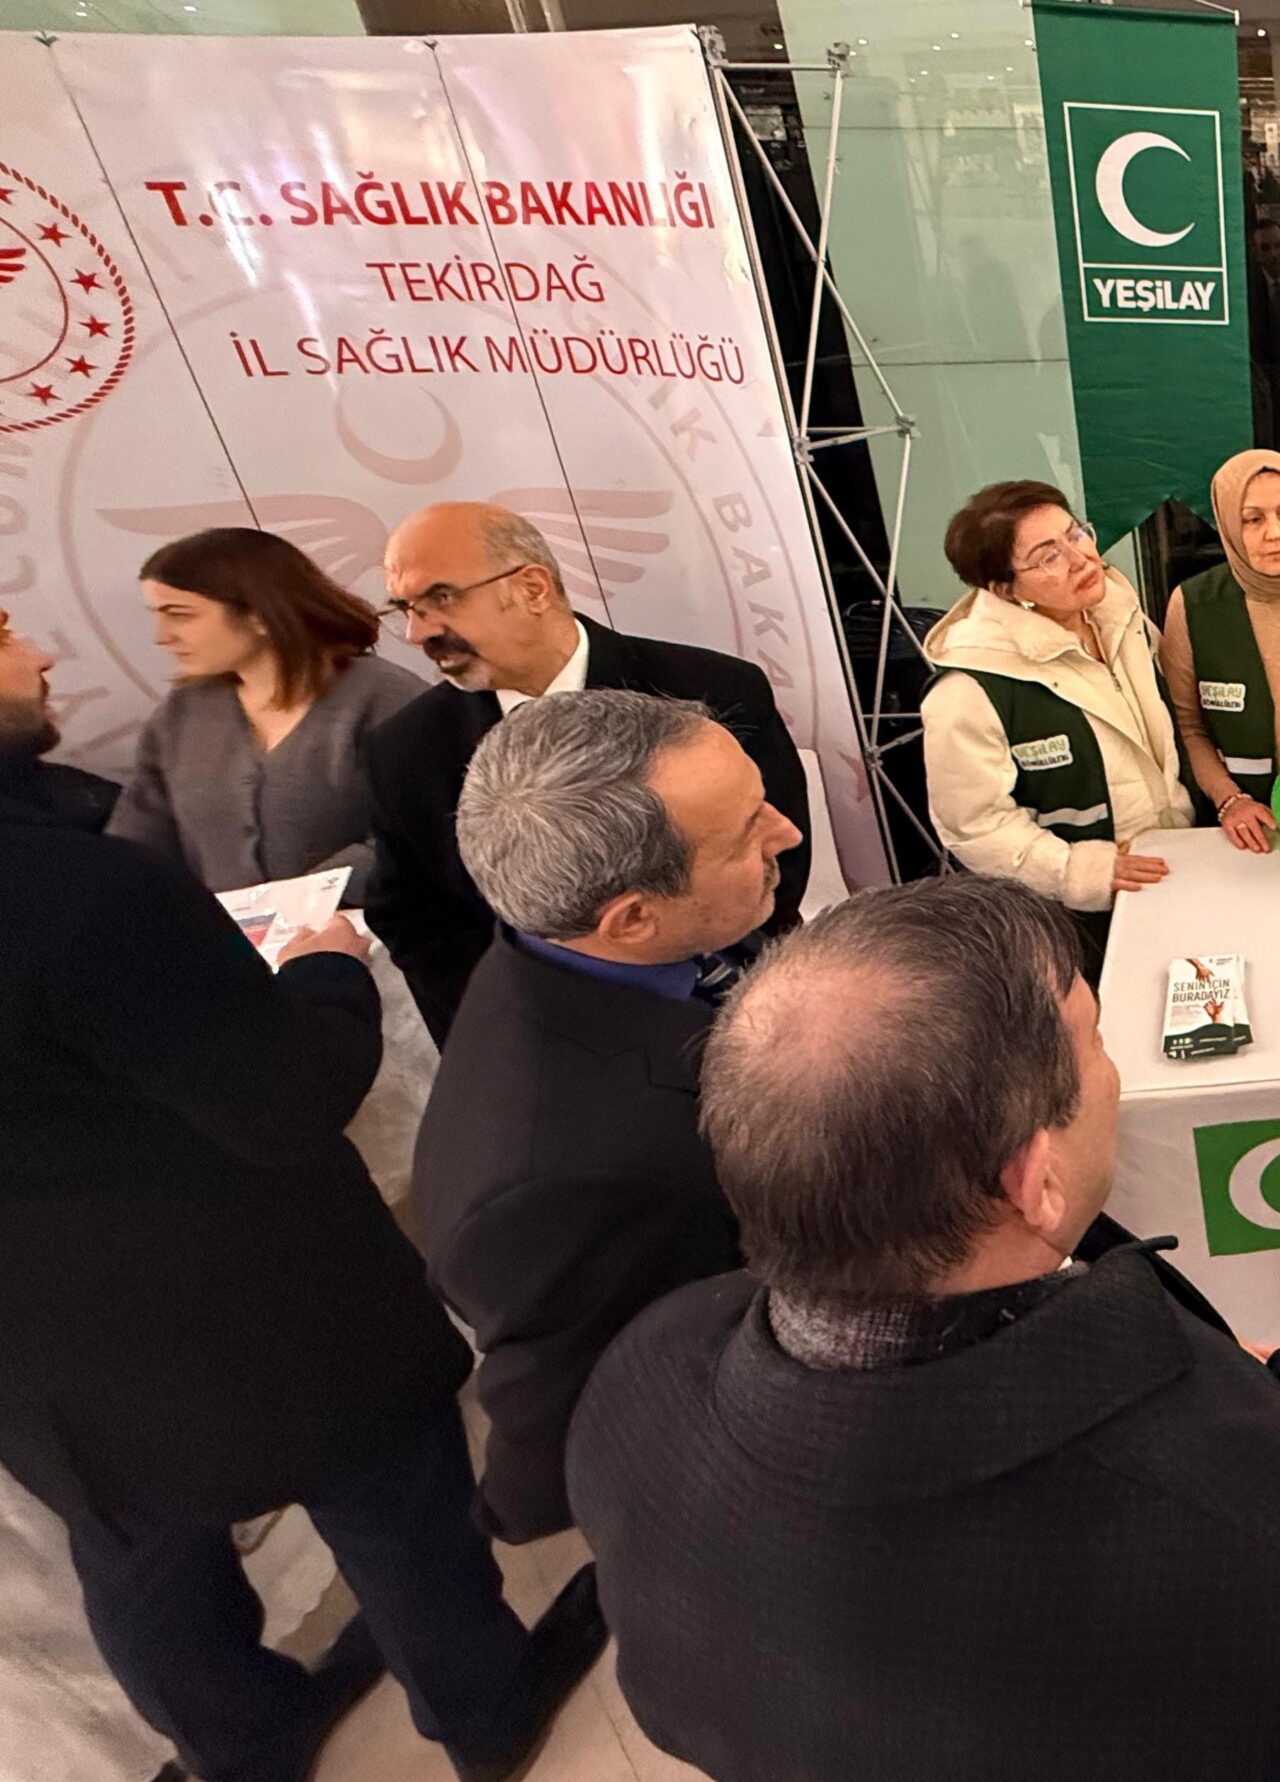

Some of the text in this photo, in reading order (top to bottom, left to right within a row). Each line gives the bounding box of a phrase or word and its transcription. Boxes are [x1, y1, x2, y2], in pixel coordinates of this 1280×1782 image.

[144, 171, 716, 229] T.C. SAĞLIK BAKANLIĞI
[366, 254, 605, 303] TEKİRDAĞ
[228, 328, 746, 385] İL SAĞLIK MÜDÜRLÜĞÜ
